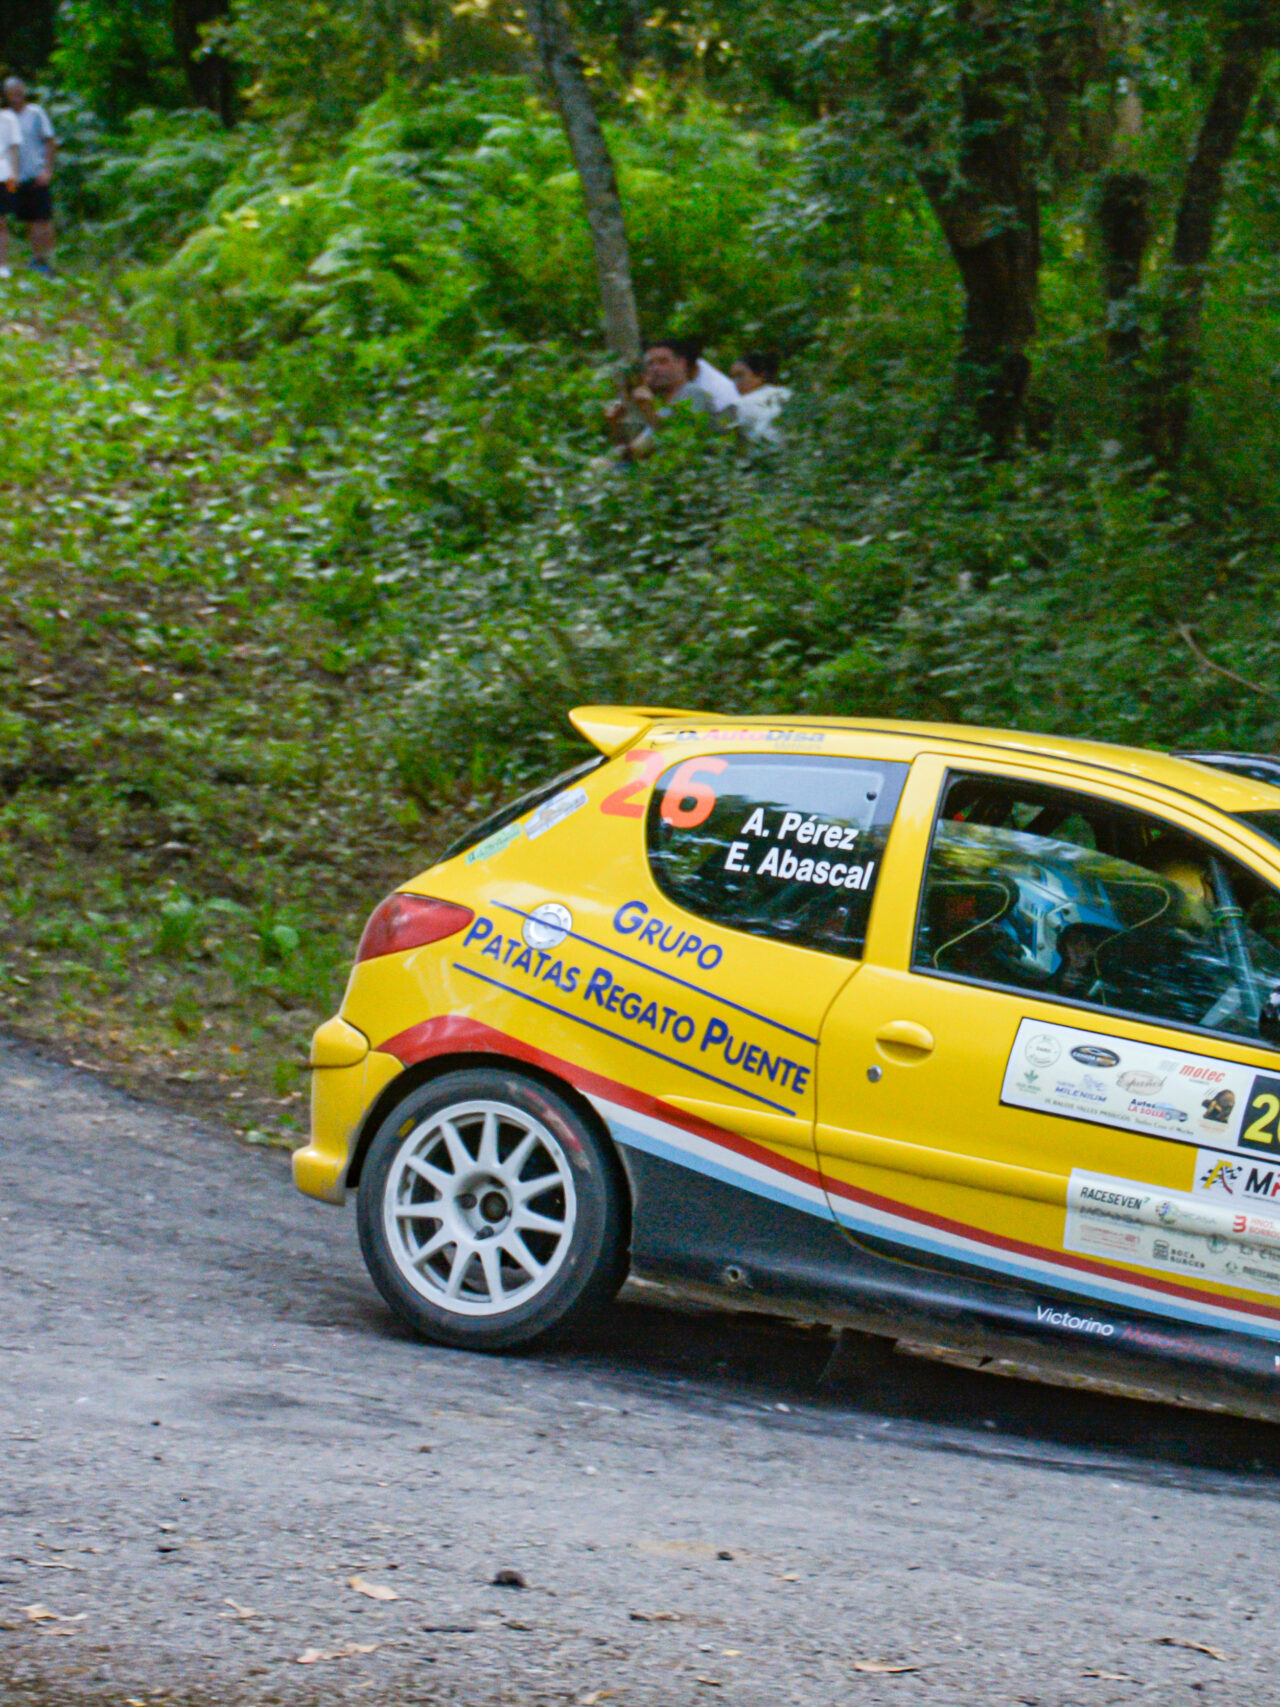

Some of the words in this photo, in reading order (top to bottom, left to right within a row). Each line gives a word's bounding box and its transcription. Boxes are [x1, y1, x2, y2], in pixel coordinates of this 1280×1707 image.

[600, 749, 729, 829] 26
[741, 808, 768, 837] A.
[778, 812, 859, 850] Pérez
[724, 841, 750, 873] E.
[757, 846, 875, 891] Abascal
[613, 900, 724, 970] GRUPO
[463, 916, 582, 994] PATATAS
[584, 966, 696, 1043] REGATO
[700, 1017, 812, 1095] PUENTE
[1179, 1064, 1227, 1084] motec
[1080, 1187, 1143, 1210] RACESEVEN
[1036, 1305, 1115, 1337] Victorino
